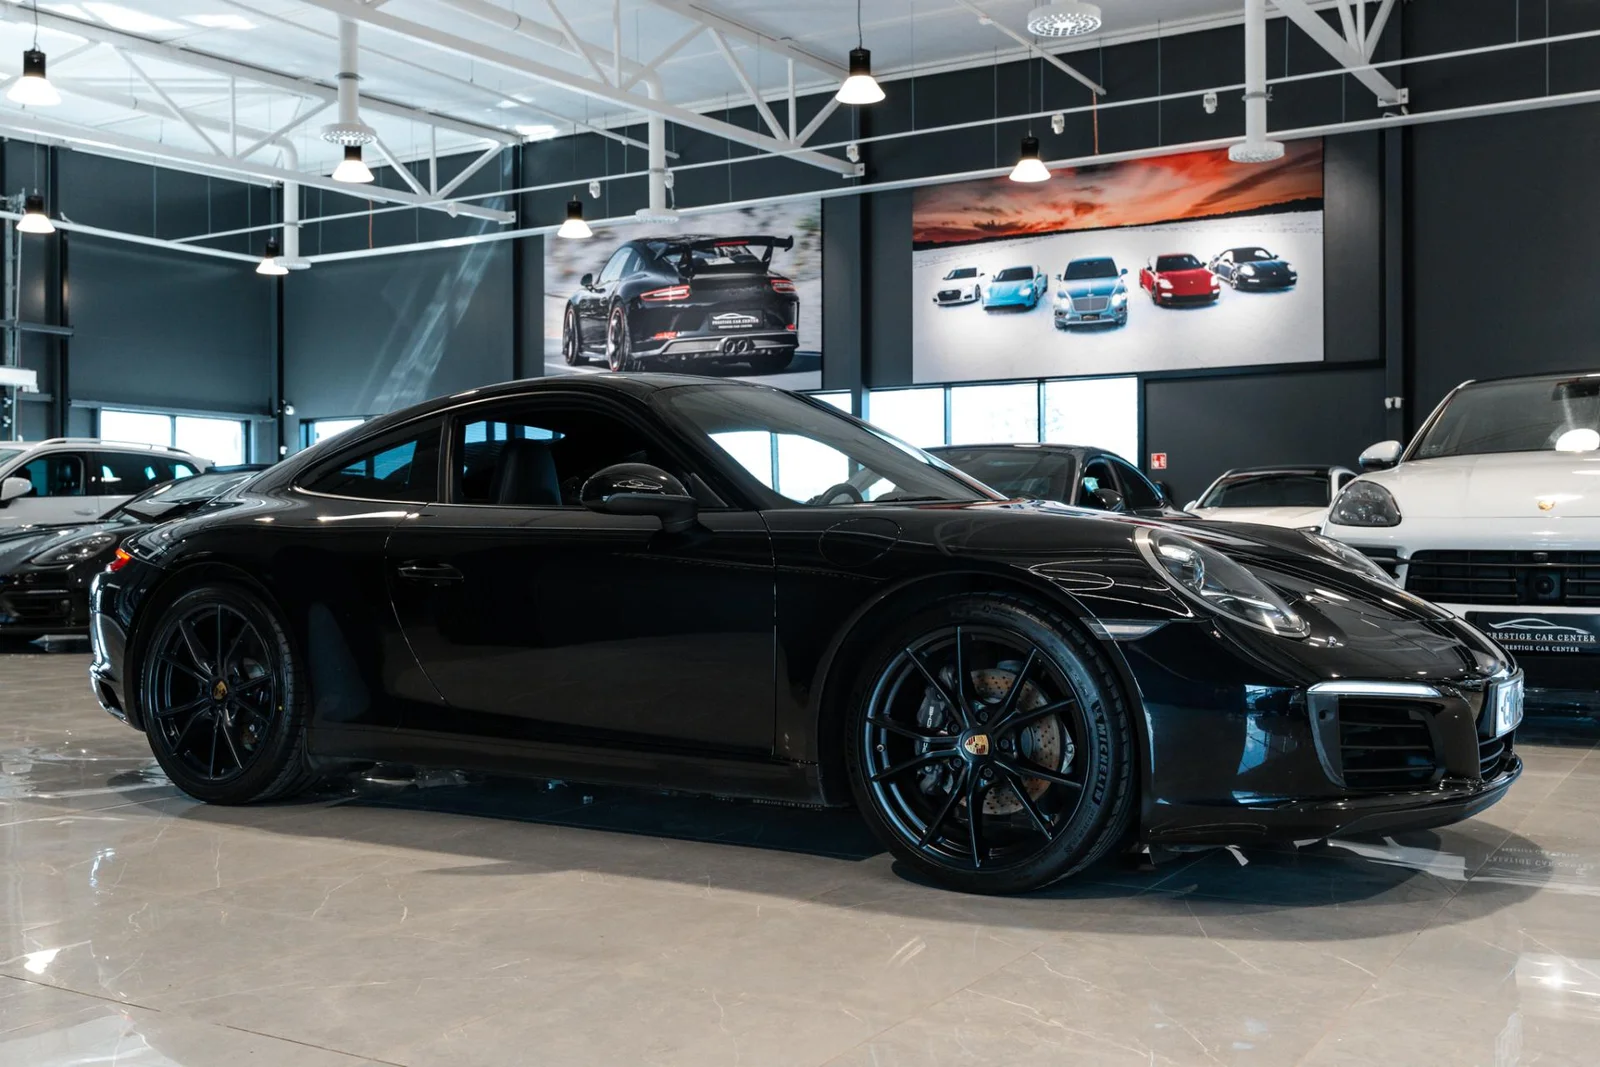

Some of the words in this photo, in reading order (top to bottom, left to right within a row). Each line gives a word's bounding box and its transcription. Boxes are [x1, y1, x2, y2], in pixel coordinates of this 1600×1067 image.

[1535, 633, 1554, 641] CAR
[1557, 634, 1597, 642] CENTER
[1095, 723, 1109, 801] MICHELIN
